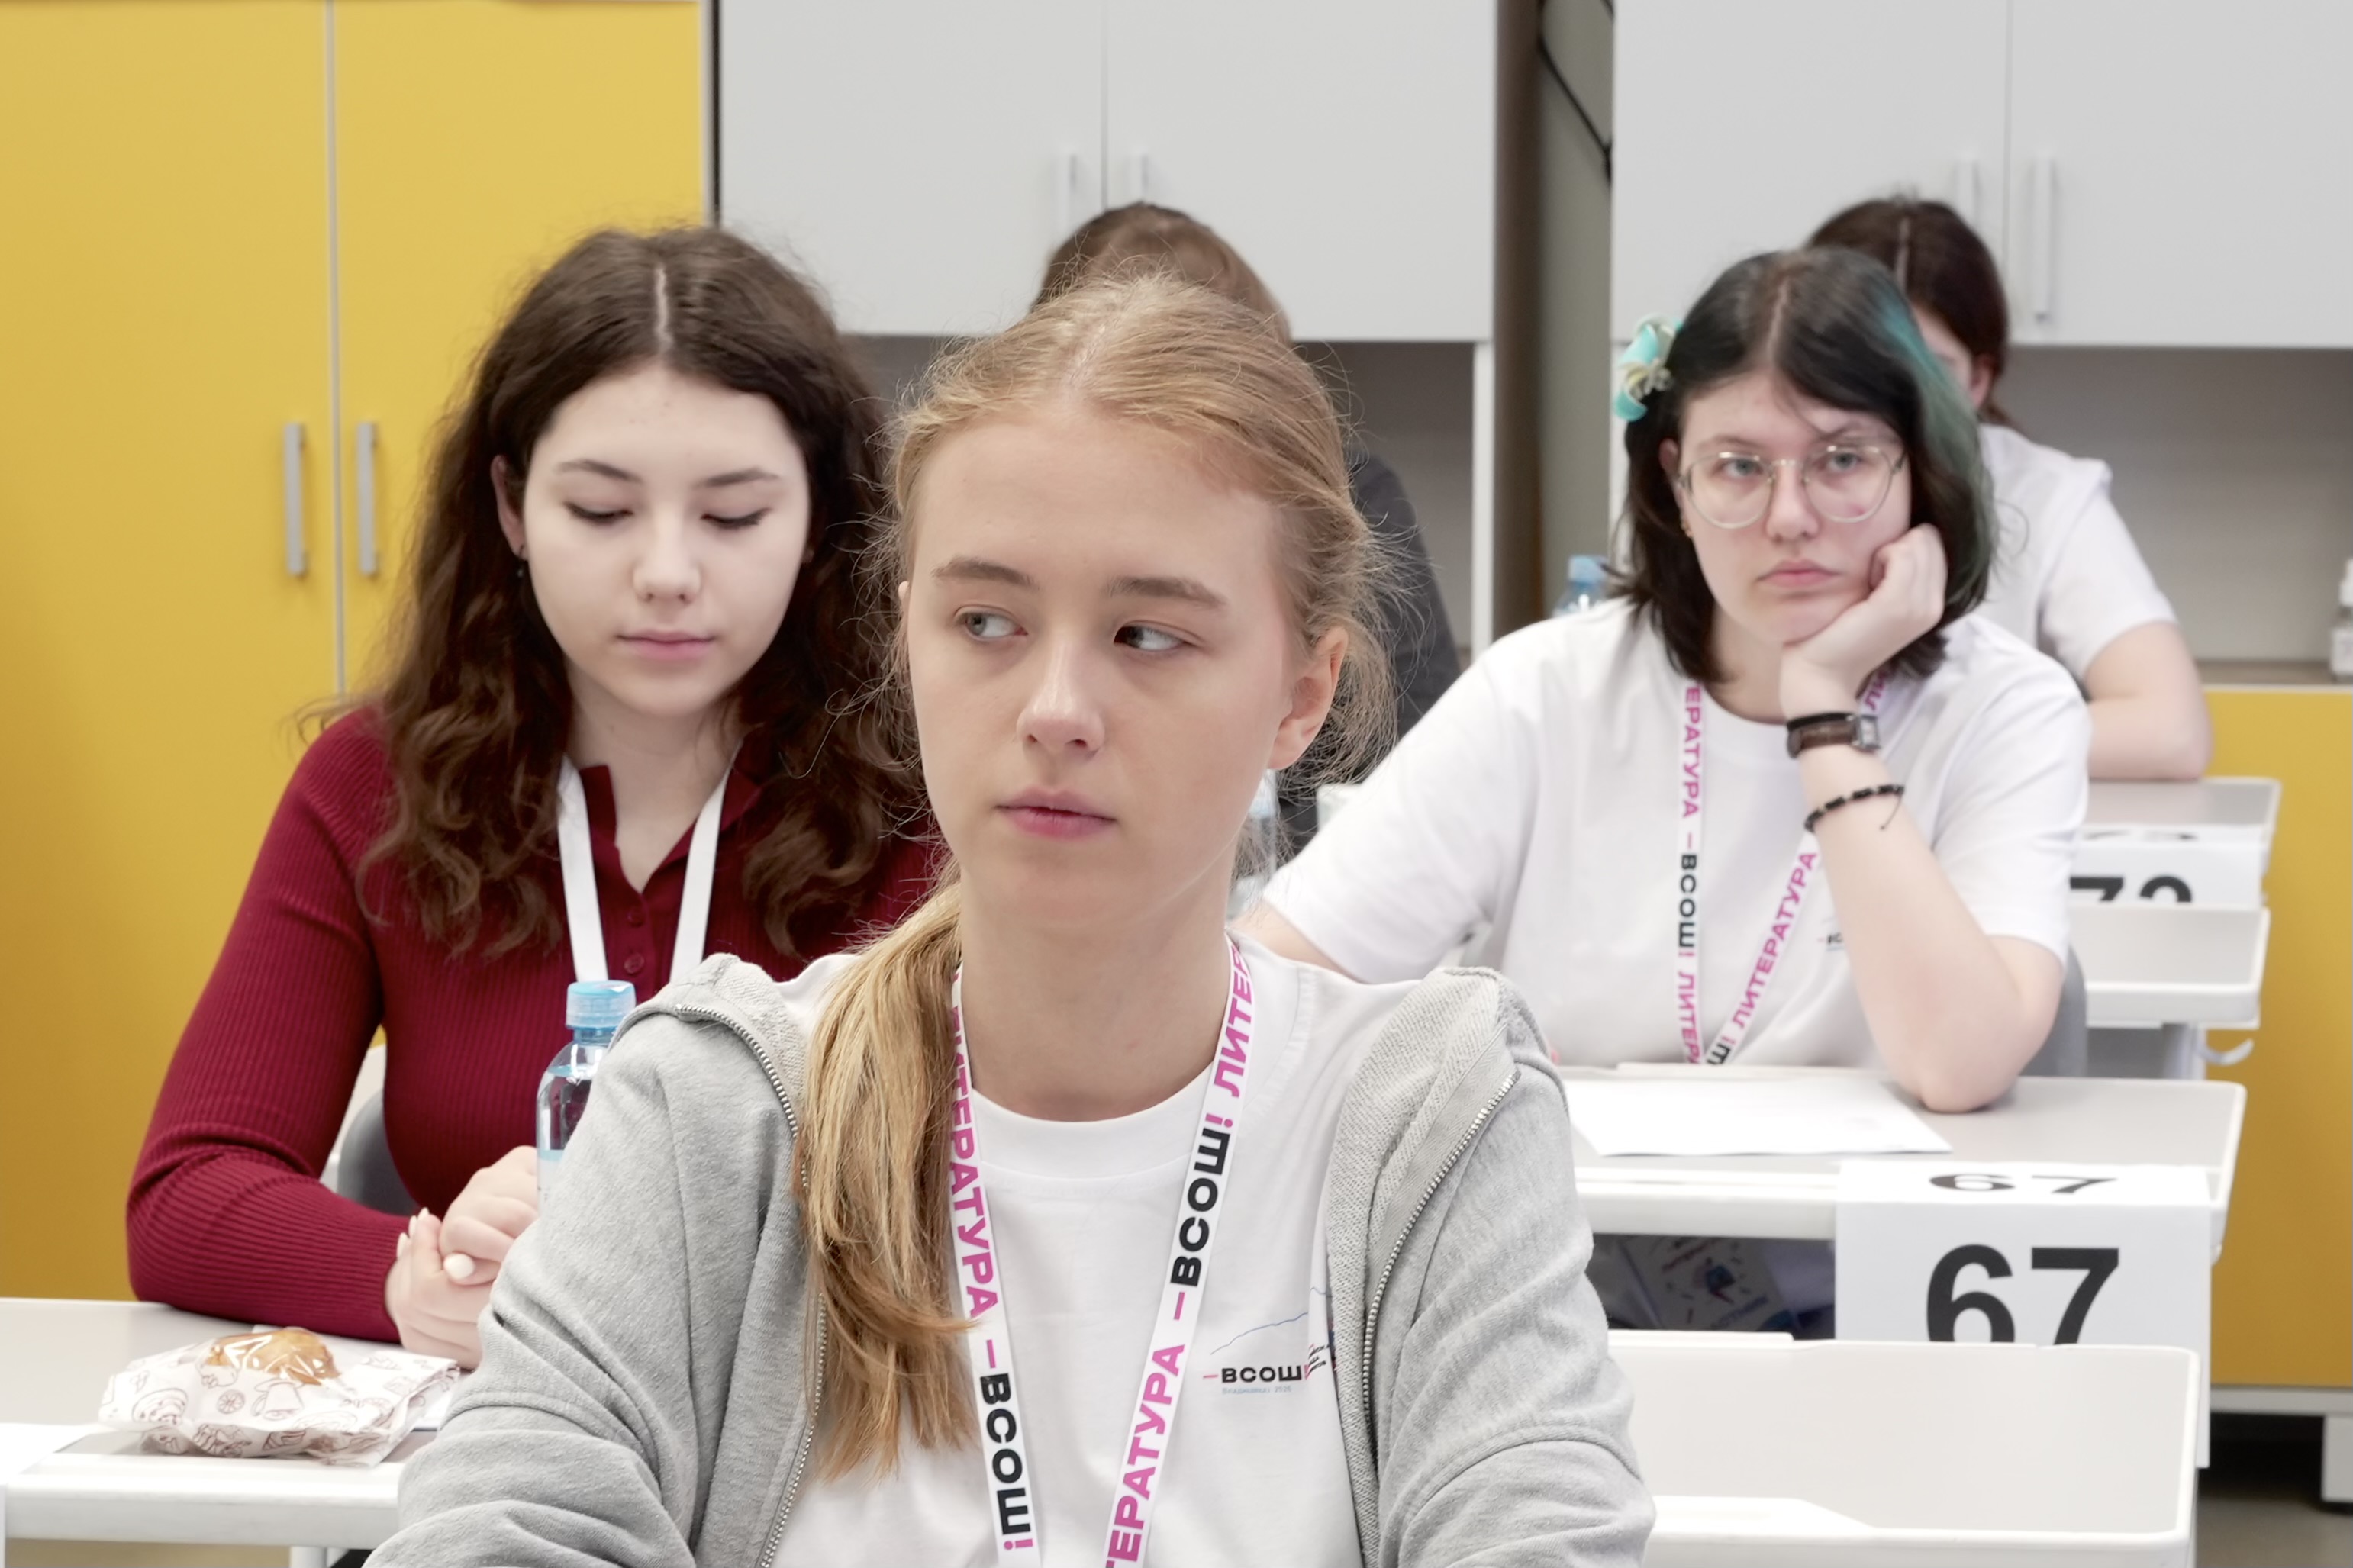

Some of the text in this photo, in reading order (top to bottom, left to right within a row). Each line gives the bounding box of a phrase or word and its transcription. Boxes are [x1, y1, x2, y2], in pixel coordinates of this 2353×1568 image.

[1683, 686, 1702, 819] ЕРАТУРА
[1731, 852, 1817, 1030] ЛИТЕРАТУРА
[1929, 1174, 2119, 1194] 67
[1926, 1244, 2119, 1345] 67
[1105, 1344, 1185, 1568] ЕРАТУРА
